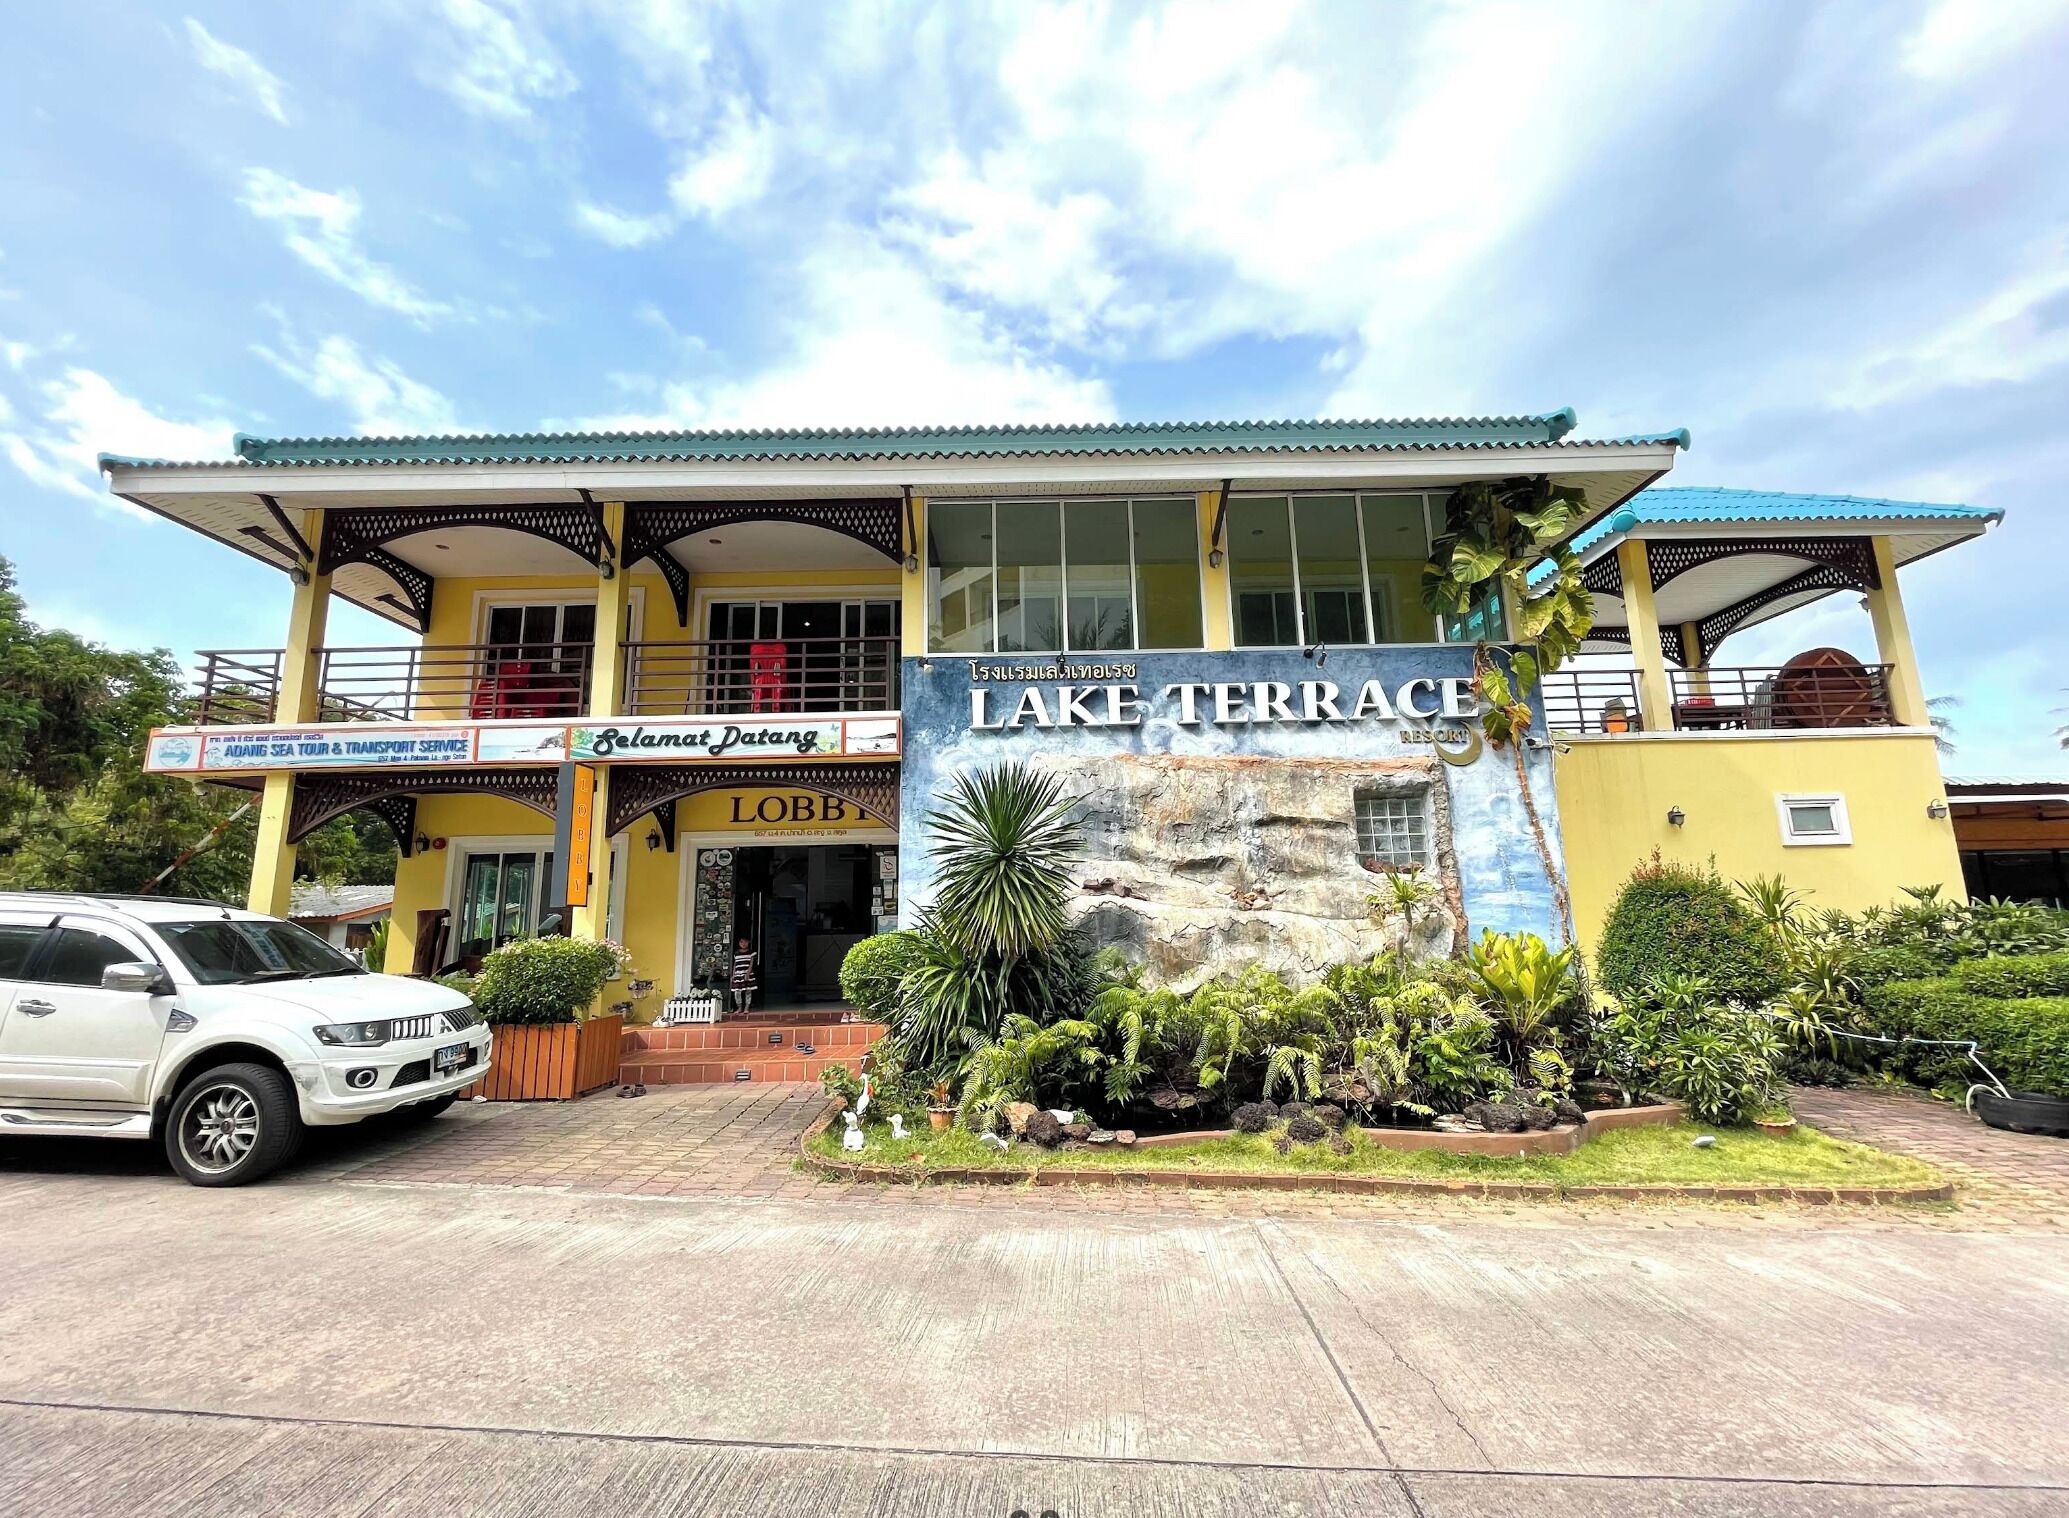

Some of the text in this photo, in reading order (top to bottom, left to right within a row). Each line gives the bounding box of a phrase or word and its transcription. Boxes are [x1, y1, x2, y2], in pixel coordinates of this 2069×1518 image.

[968, 677, 1480, 730] LAKE TERRACE
[224, 739, 468, 757] ADANG SEA TOUR & TRANSPORT SERVICE
[592, 725, 819, 756] Selamat Datang
[1400, 727, 1470, 744] RESORT
[575, 779, 589, 891] LOBBY
